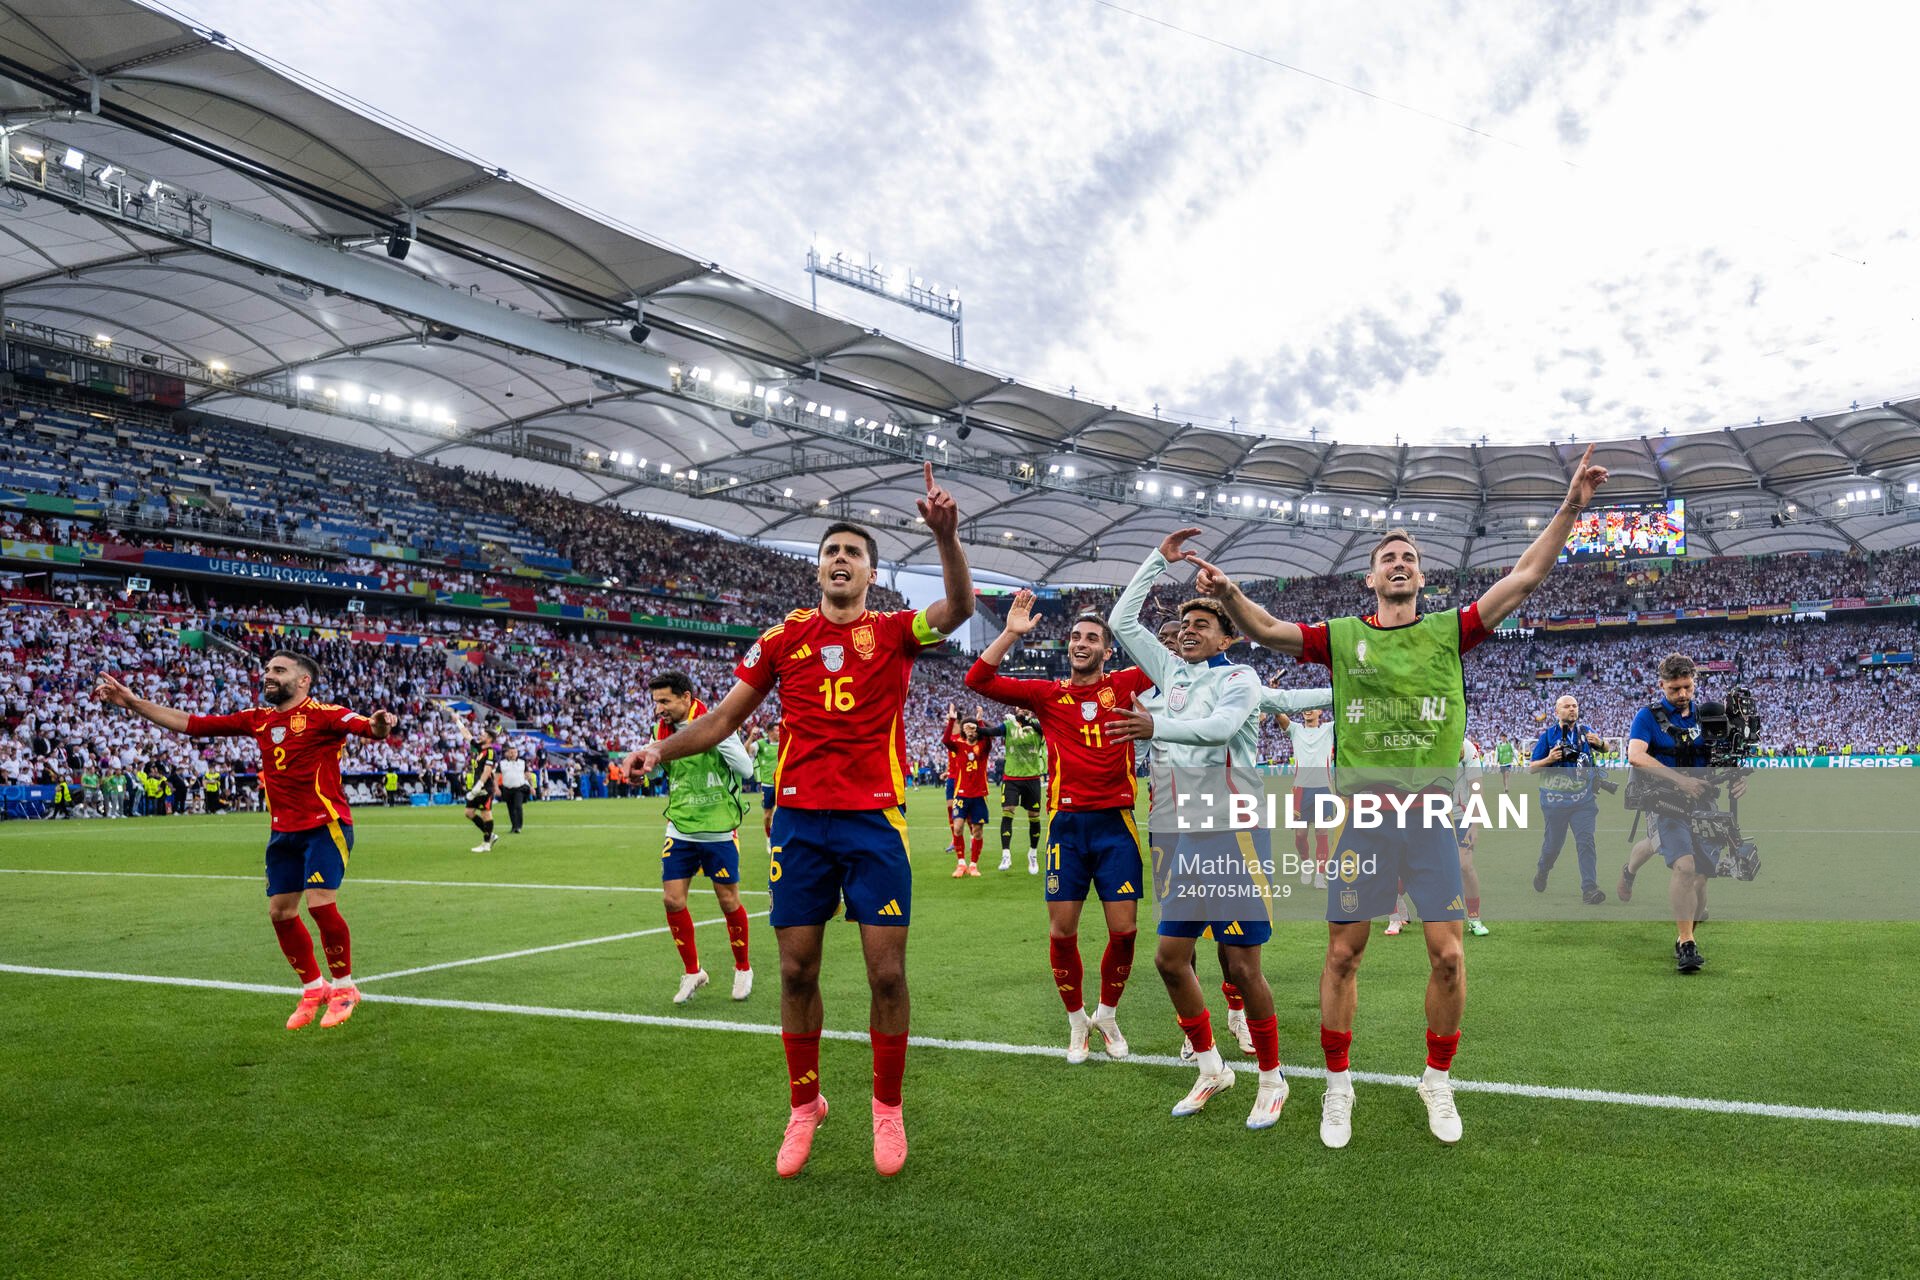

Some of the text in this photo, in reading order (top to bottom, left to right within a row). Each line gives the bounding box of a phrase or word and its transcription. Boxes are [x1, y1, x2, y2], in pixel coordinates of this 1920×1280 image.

[668, 618, 728, 632] STUTTGART
[818, 676, 856, 712] 16
[1080, 724, 1102, 748] 11
[1383, 734, 1436, 747] RESPECT
[273, 746, 287, 771] 2
[1828, 756, 1913, 768] Hisense
[1046, 843, 1060, 871] 11
